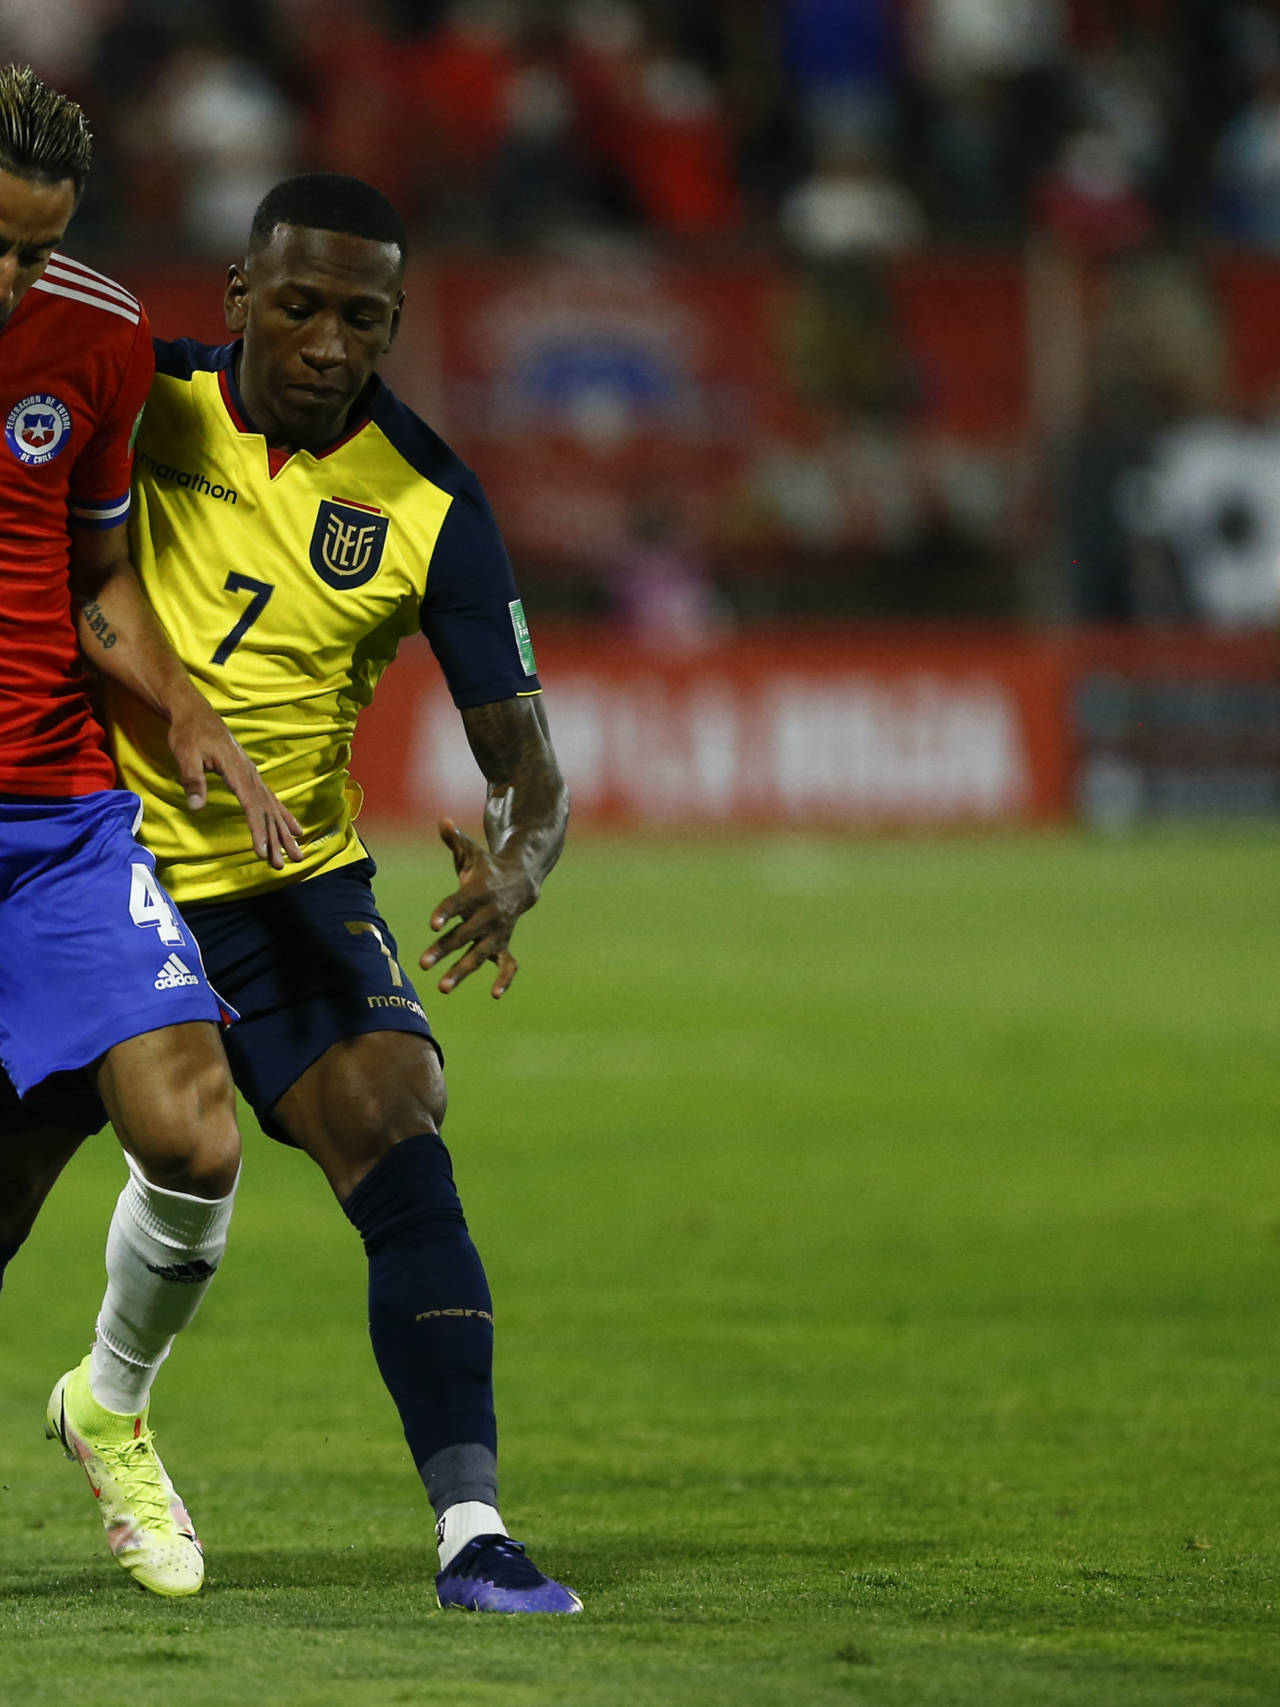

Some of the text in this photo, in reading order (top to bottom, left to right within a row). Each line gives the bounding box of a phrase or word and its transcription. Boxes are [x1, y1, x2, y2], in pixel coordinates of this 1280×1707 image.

[209, 569, 276, 667] 7
[128, 863, 186, 947] 4
[154, 973, 199, 990] adidas
[343, 920, 403, 988] 7
